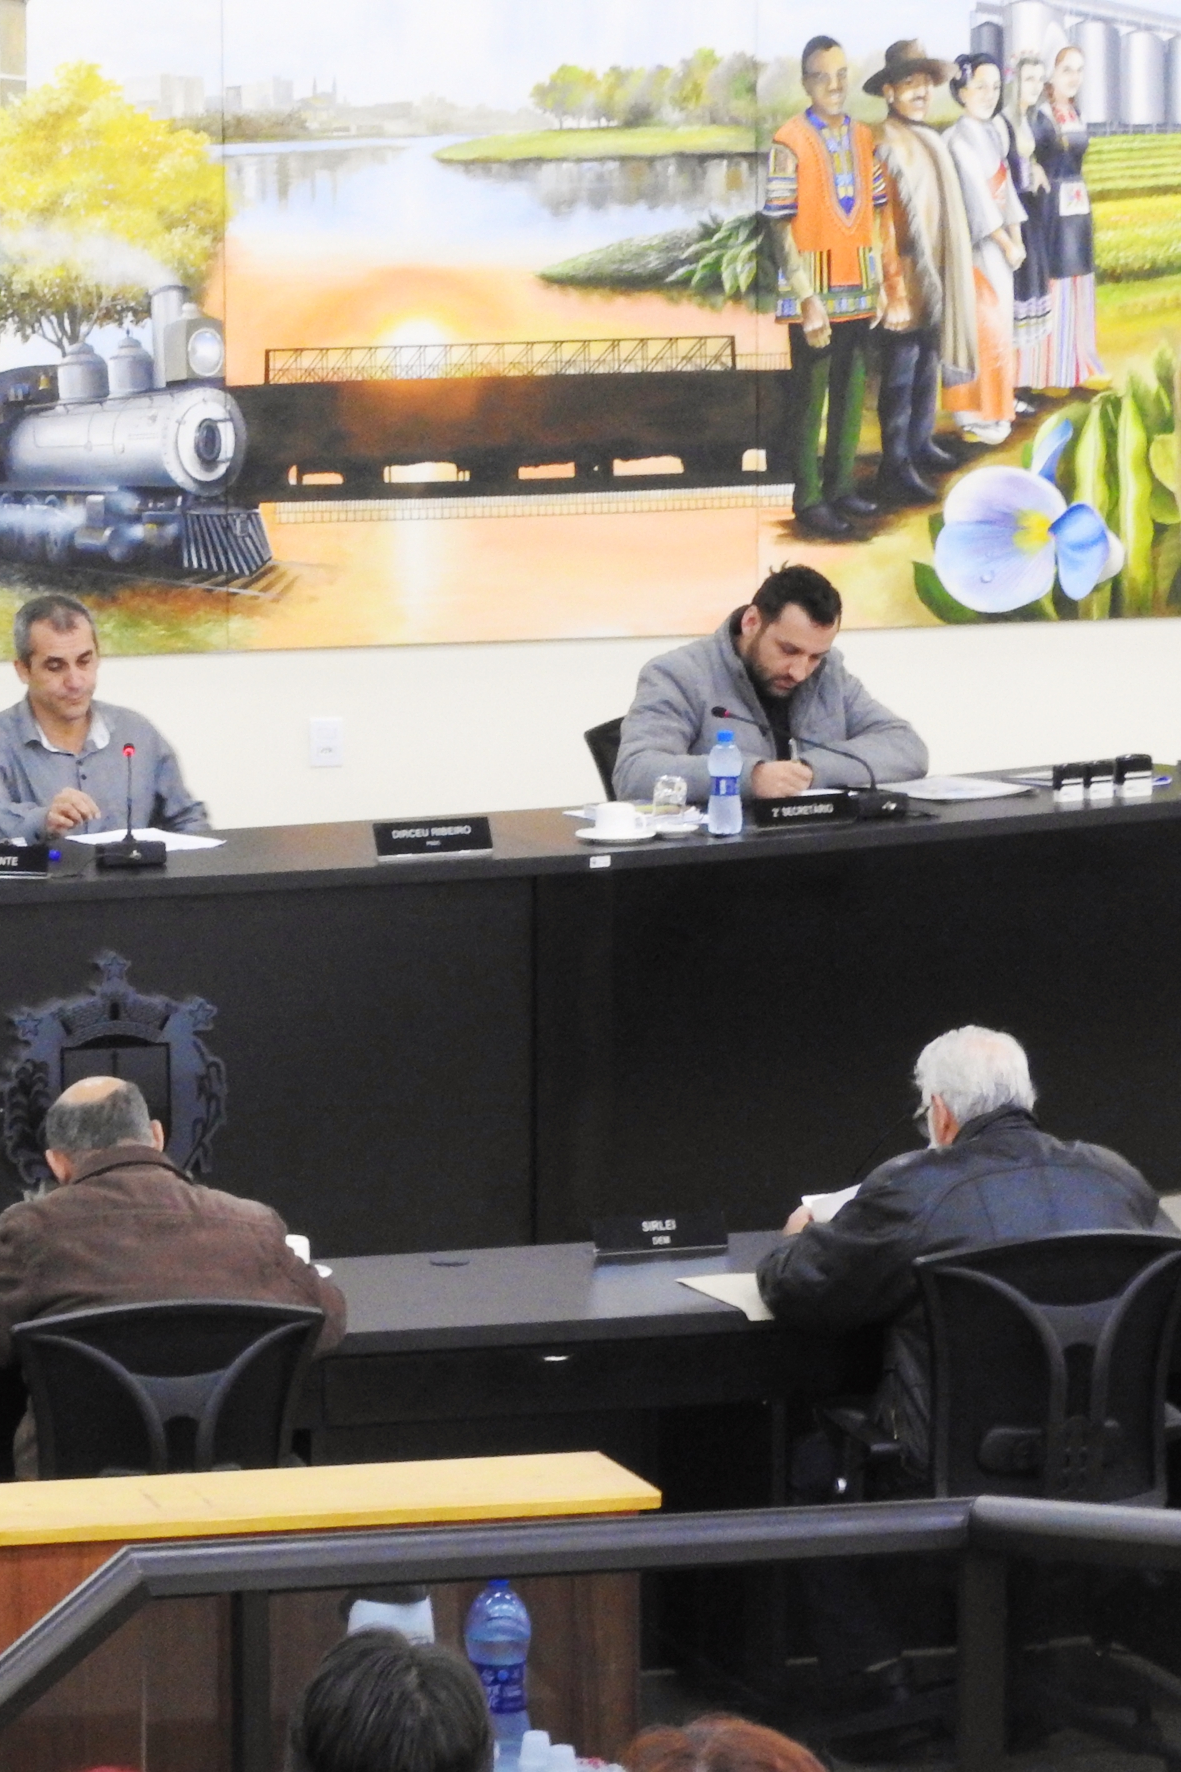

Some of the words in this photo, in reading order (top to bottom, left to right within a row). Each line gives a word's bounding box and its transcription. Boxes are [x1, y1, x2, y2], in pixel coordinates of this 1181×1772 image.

[391, 828, 429, 839] DIRCEU
[430, 825, 472, 837] RIBEIRO
[641, 1219, 677, 1232] SIRLEI
